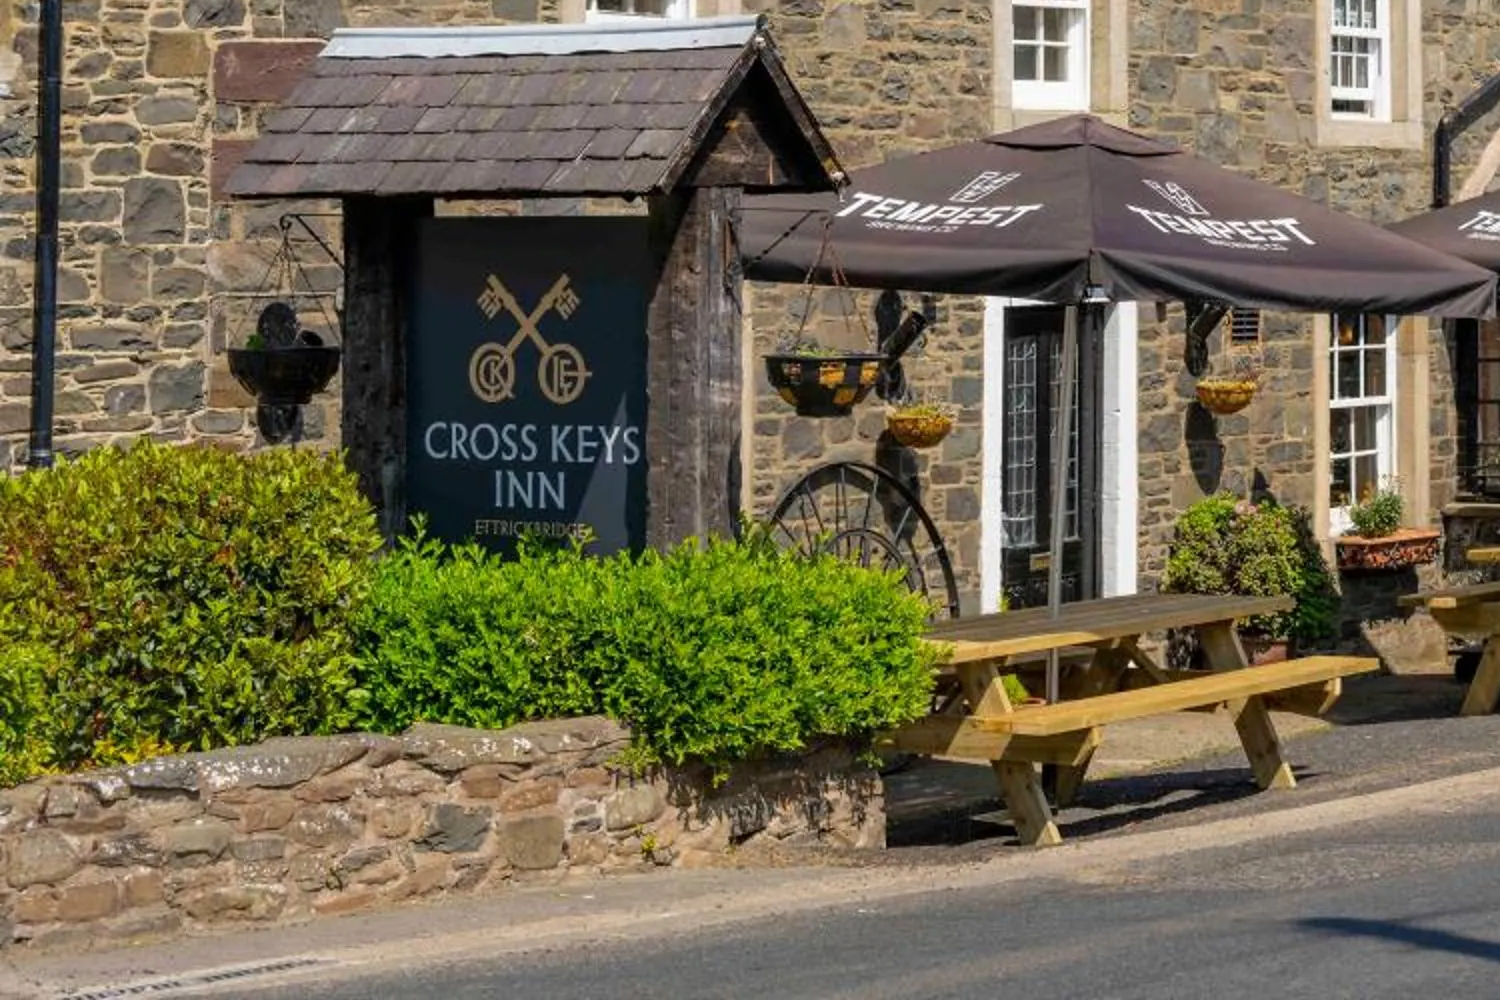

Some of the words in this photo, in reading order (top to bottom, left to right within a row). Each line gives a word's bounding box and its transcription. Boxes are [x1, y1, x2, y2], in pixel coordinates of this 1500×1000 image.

[835, 191, 1044, 228] TEMPEST
[1126, 203, 1317, 245] TEMPEST
[425, 421, 538, 463] CROSS
[551, 424, 641, 465] KEYS
[494, 470, 567, 510] INN
